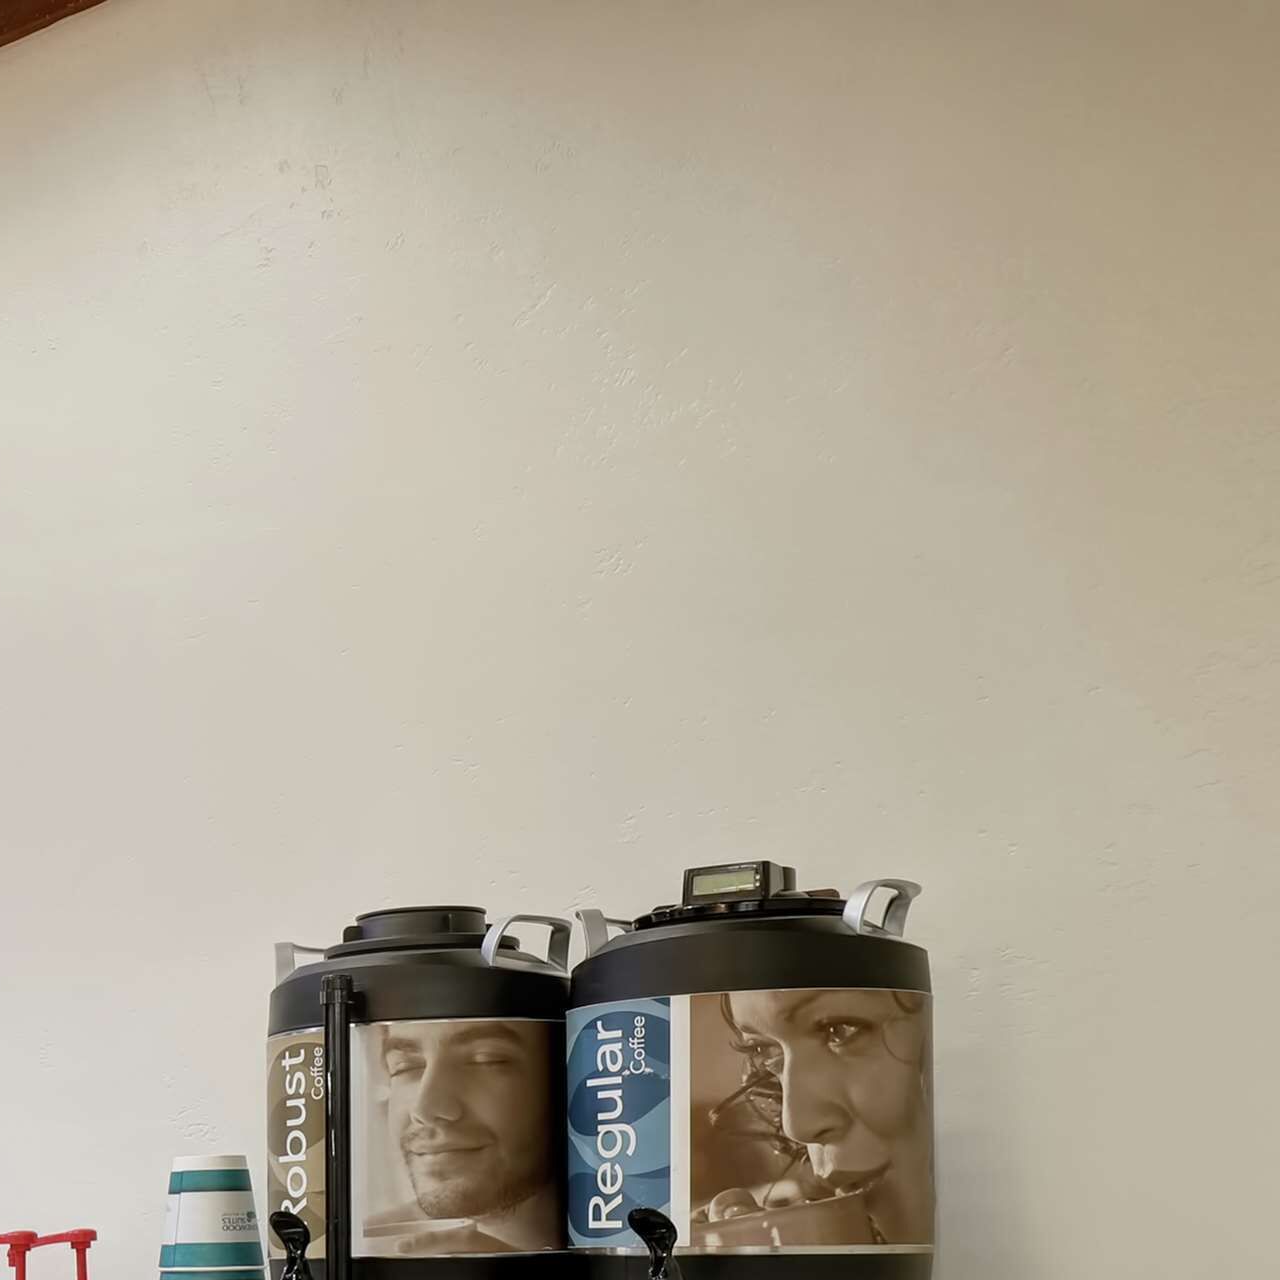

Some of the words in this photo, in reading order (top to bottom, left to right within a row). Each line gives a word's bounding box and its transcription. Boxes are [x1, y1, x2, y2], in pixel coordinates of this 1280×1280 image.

[311, 1046, 324, 1101] Coffee
[628, 1015, 646, 1075] Coffee
[586, 1020, 637, 1229] Regular
